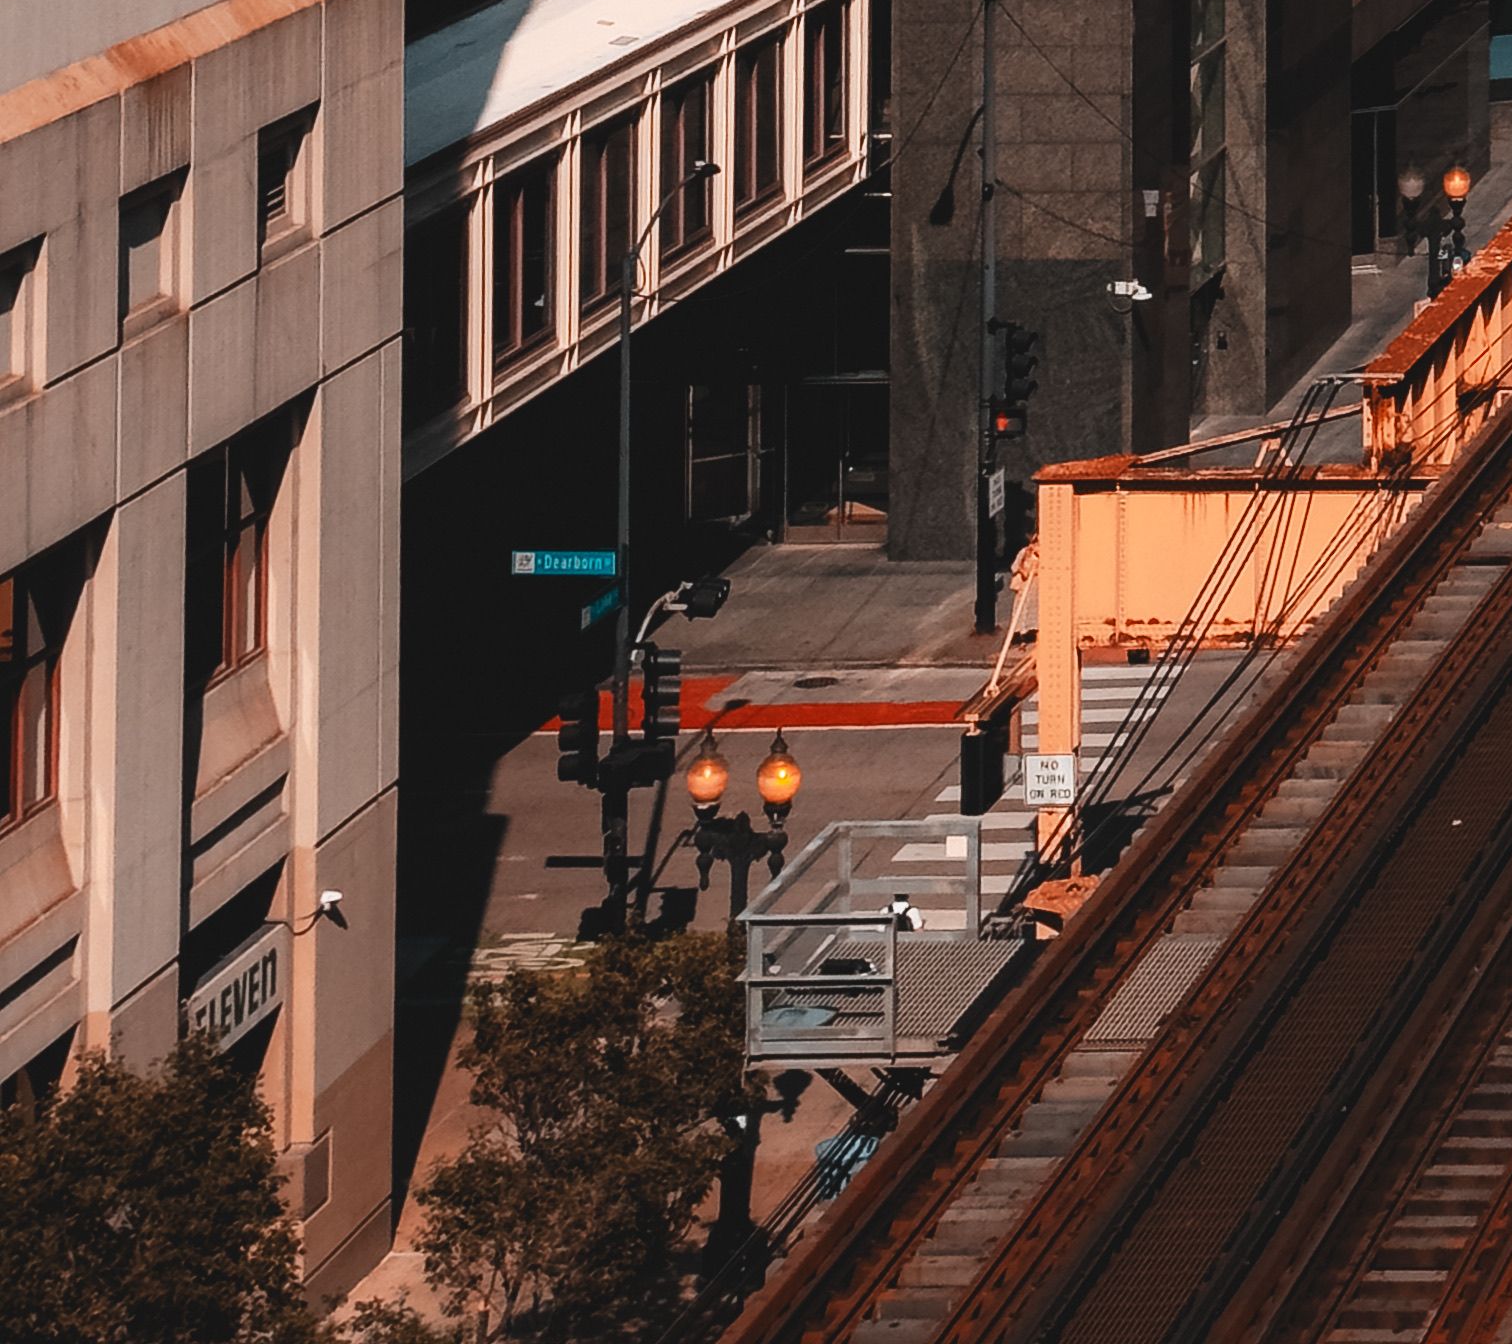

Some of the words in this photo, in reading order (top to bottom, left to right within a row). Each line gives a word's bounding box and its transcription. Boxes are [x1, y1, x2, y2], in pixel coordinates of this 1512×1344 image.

[544, 554, 602, 570] Dearborn
[1040, 761, 1059, 771] NO
[1035, 774, 1065, 785] TURN
[1029, 789, 1045, 799] ON
[1050, 789, 1071, 799] RED
